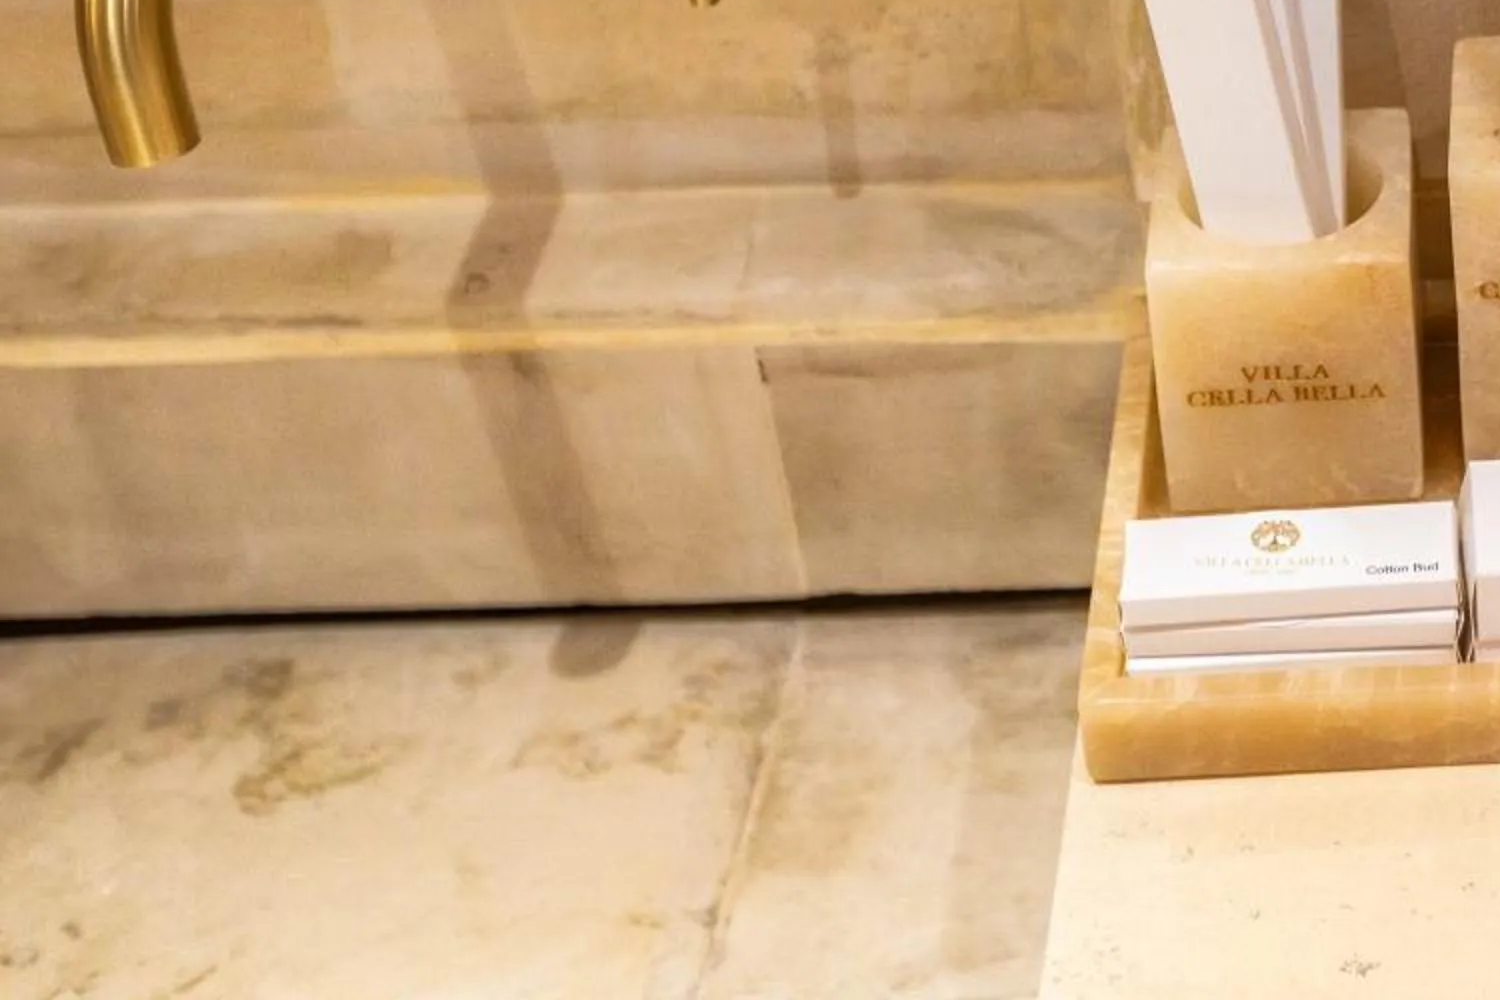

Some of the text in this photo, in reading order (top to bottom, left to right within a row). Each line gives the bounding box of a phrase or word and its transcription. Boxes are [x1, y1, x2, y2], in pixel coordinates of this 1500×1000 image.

[1240, 363, 1330, 383] VILLA
[1293, 383, 1387, 402] BELLA
[1365, 561, 1410, 576] Cotton
[1412, 560, 1440, 575] Bud
